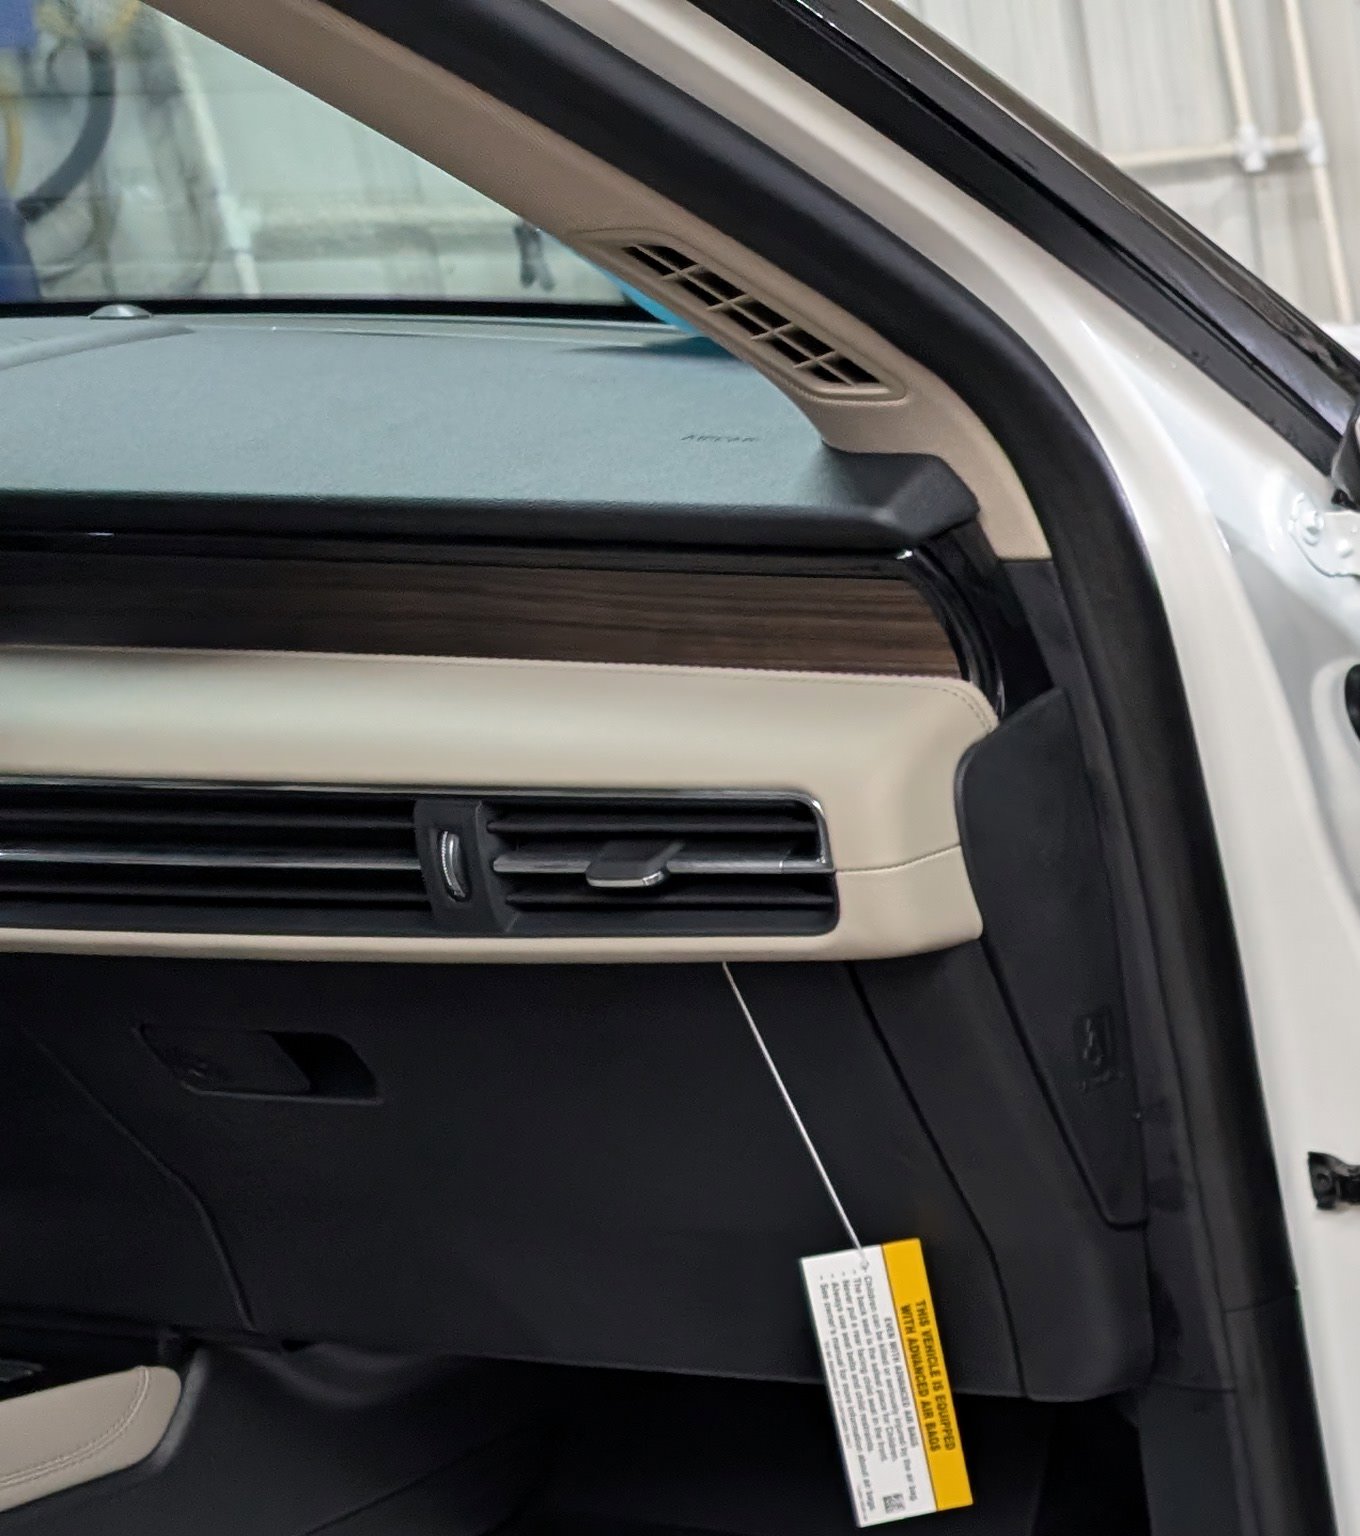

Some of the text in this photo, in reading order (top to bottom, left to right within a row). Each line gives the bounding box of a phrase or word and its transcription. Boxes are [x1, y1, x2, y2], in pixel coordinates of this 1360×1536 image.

[852, 1277, 863, 1293] The
[856, 1295, 867, 1316] back
[900, 1304, 941, 1452] WITH ADVANCED AIR BAGS
[915, 1300, 956, 1450] THIS VEHICLE IS EQUIPPED
